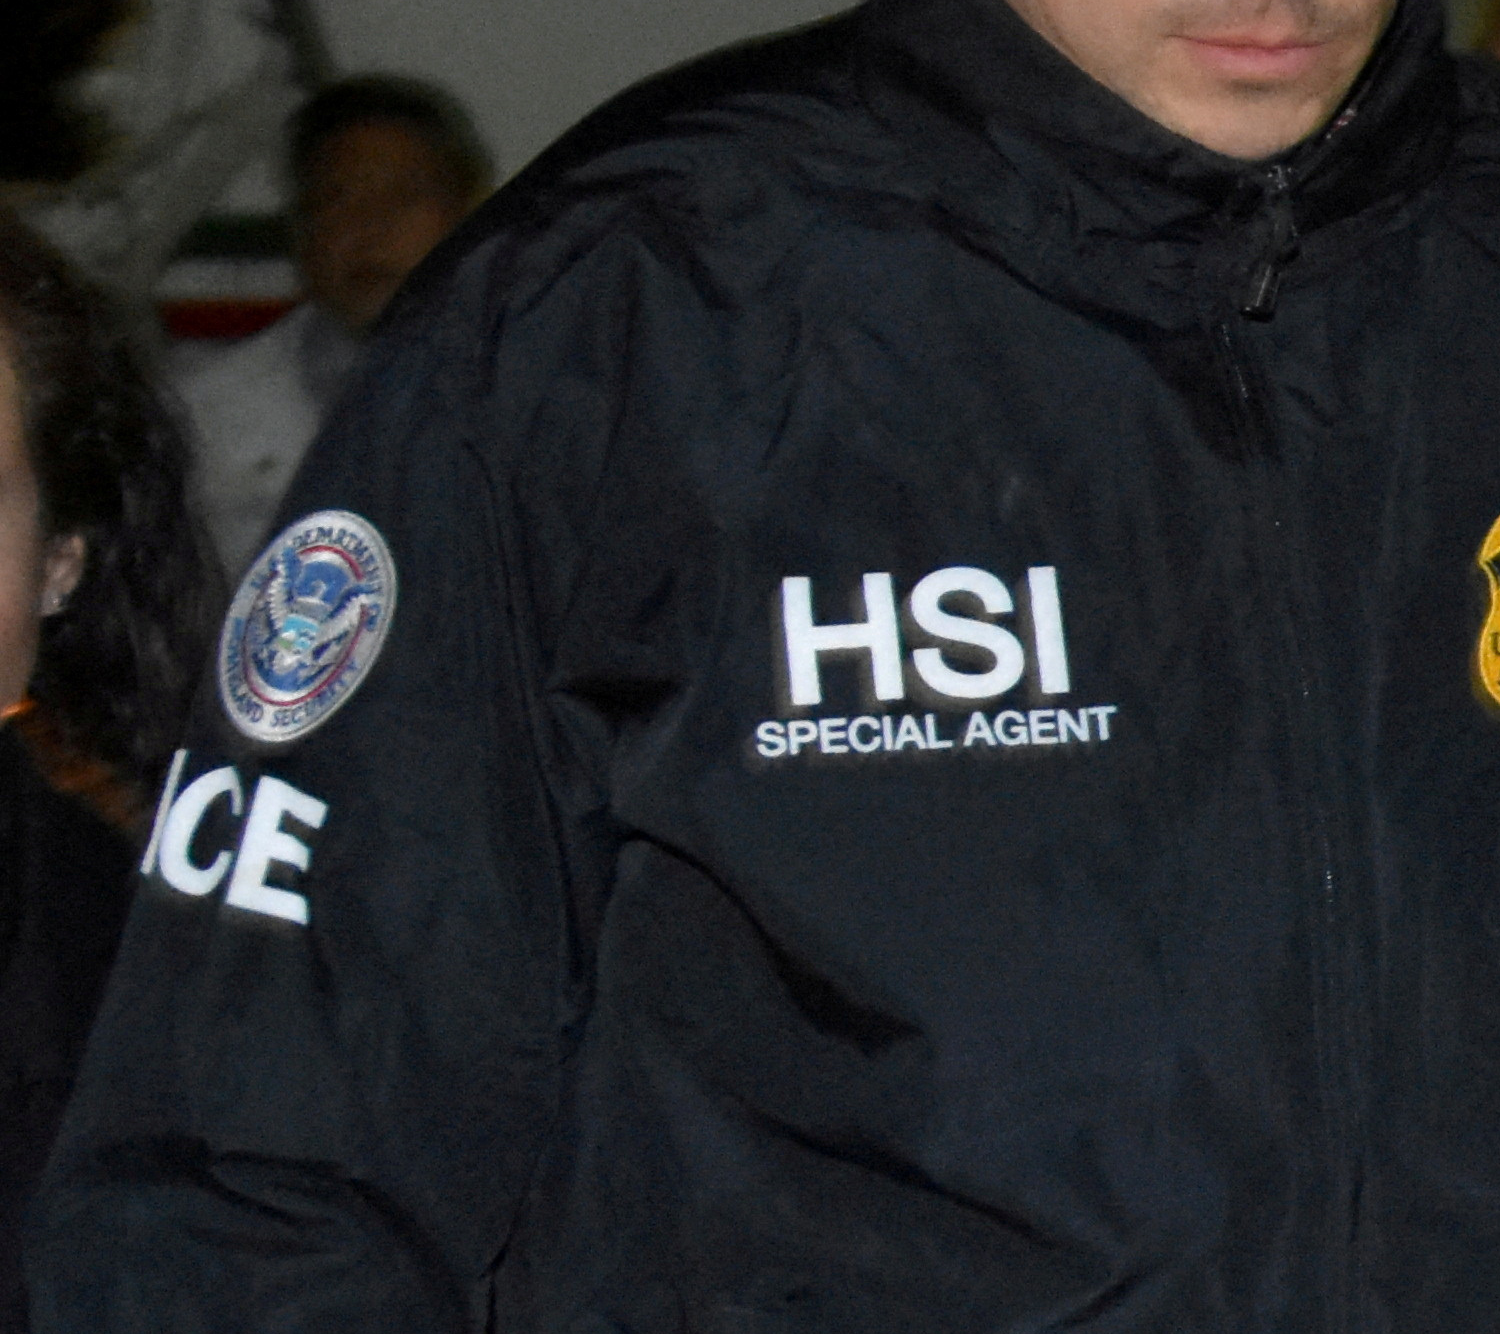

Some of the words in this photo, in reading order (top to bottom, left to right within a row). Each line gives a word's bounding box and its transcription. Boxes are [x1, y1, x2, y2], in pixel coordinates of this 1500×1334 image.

[782, 566, 1070, 706] HSI
[756, 713, 953, 758] SPECIAL
[963, 704, 1117, 747] AGENT
